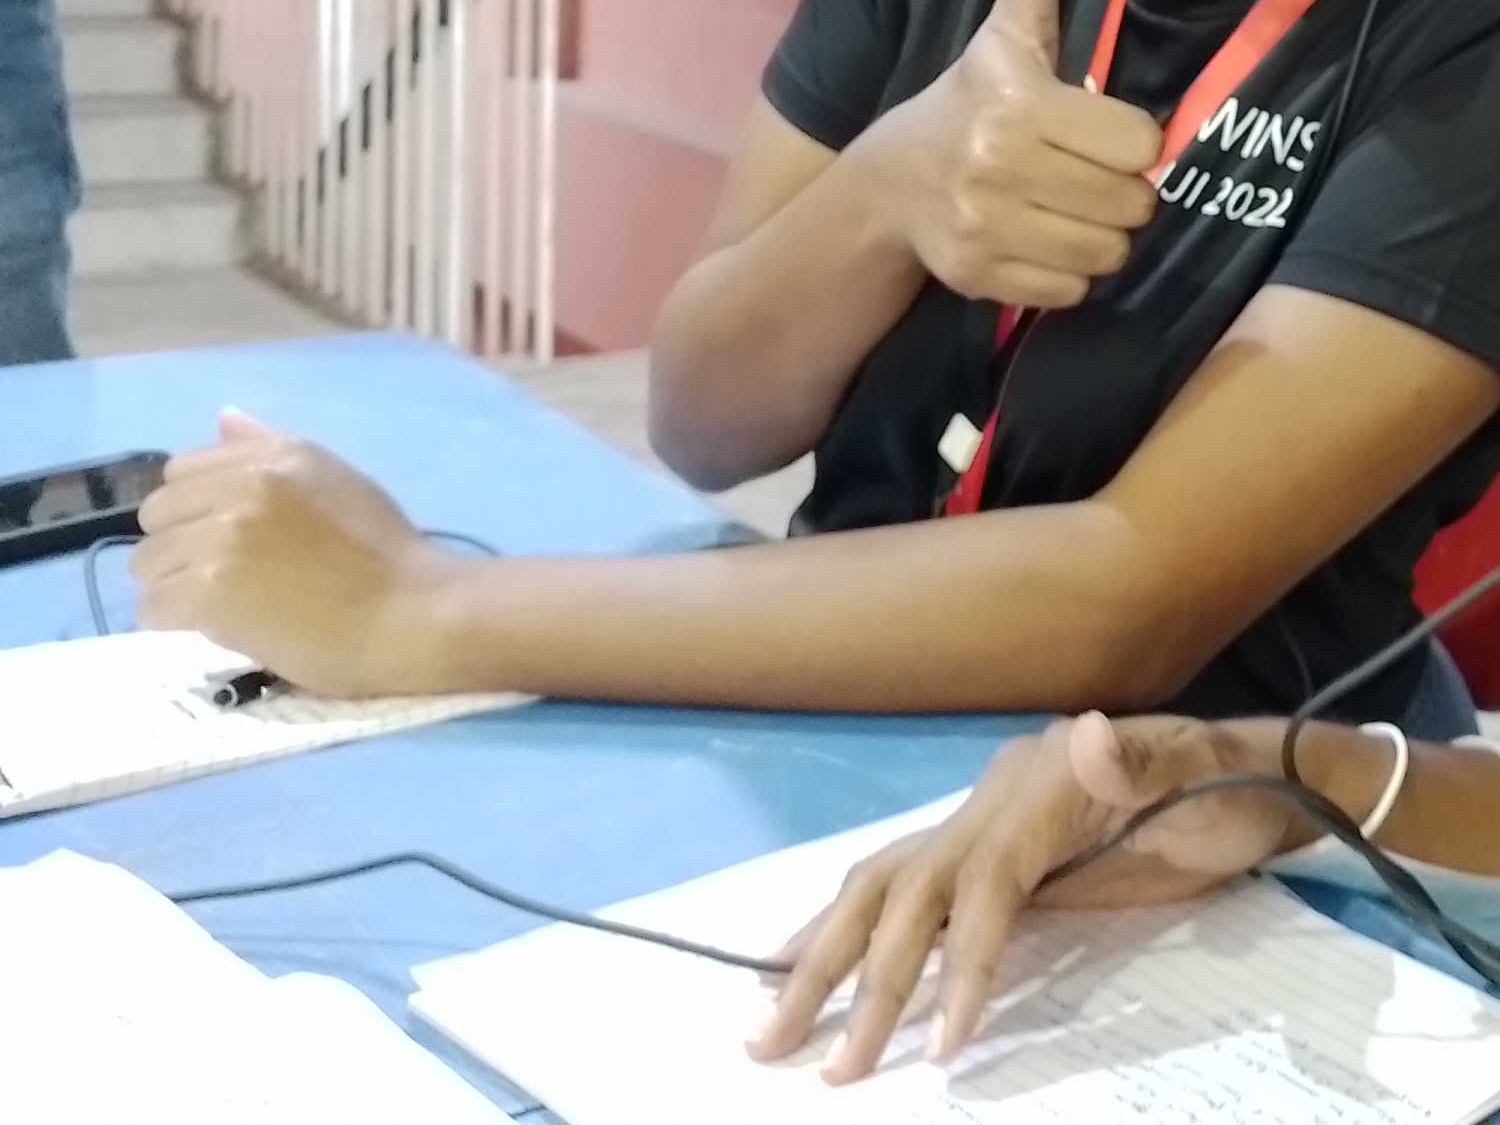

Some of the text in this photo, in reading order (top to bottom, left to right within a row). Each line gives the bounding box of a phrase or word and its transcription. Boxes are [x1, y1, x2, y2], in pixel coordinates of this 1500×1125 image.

[1197, 96, 1323, 172] WINS
[1154, 160, 1295, 229] IJI 2022
